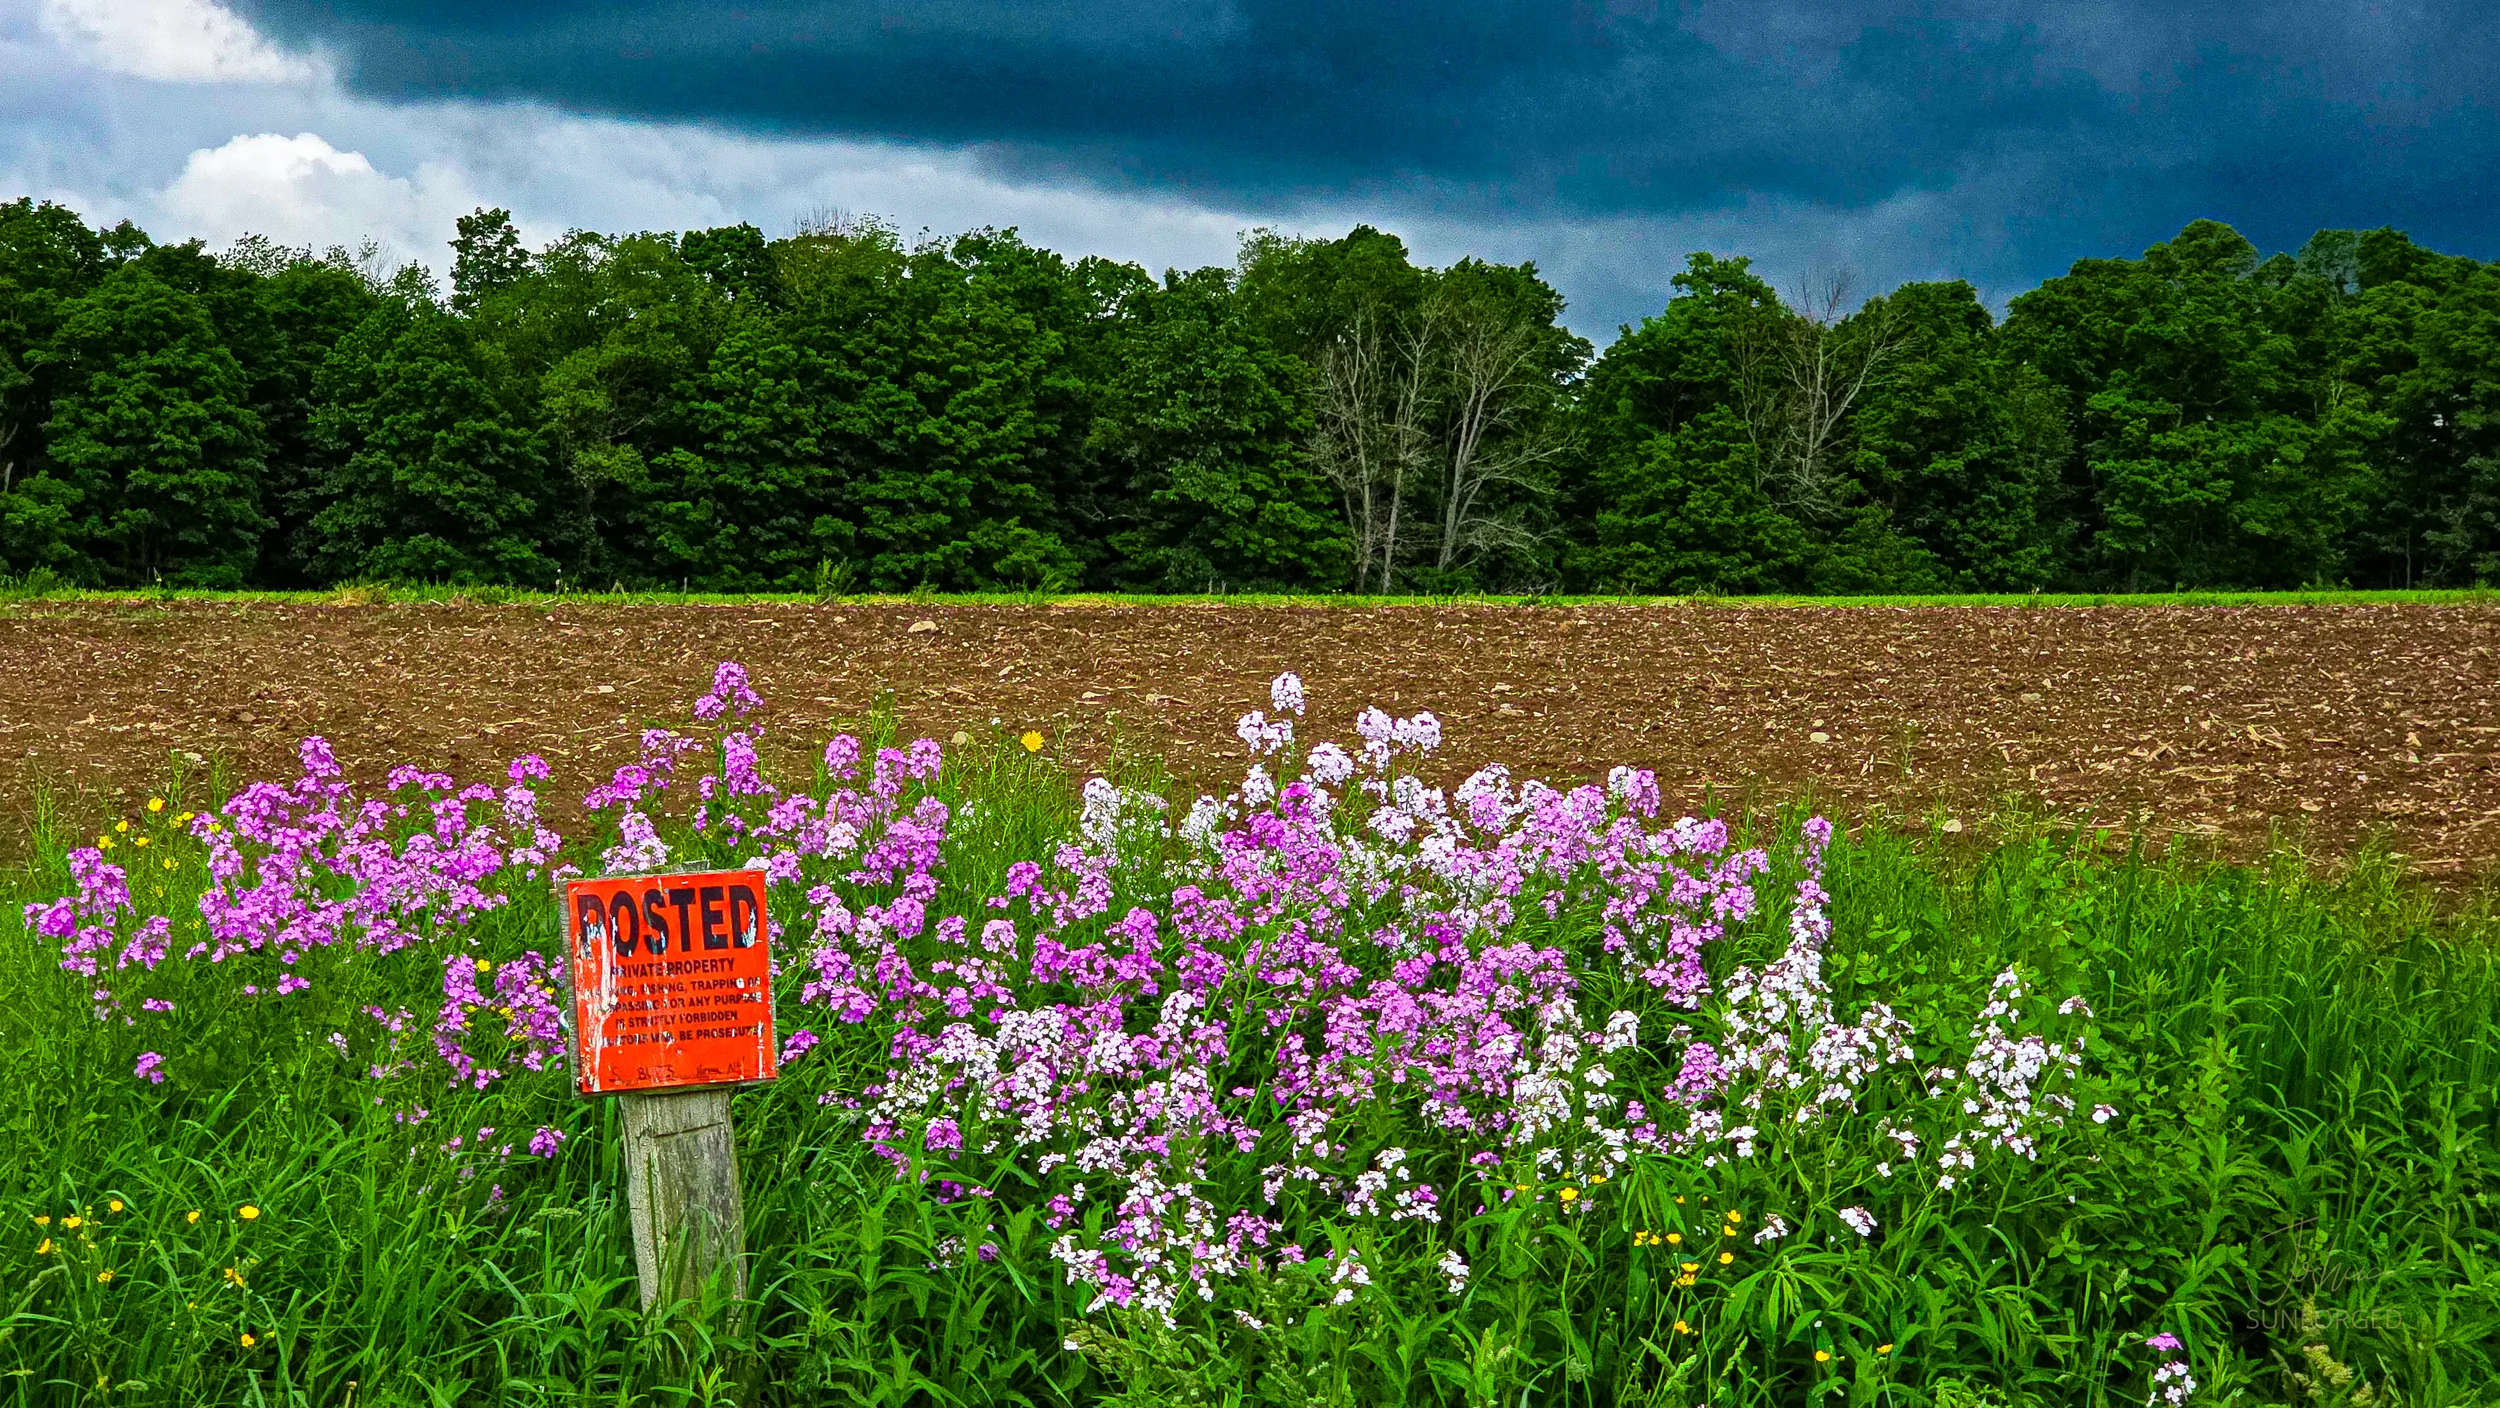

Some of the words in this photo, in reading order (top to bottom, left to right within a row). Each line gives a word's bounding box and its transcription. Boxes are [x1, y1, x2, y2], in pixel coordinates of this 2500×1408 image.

[577, 885, 759, 957] POSTED
[611, 962, 664, 978] PRIVATE
[667, 957, 735, 976] PROPERTY
[690, 977, 744, 991] TRAPPIN
[689, 996, 710, 1008] ANY
[714, 992, 762, 1006] PURPS
[680, 1010, 738, 1023] FORBIDDEN
[679, 1029, 693, 1041] BE
[696, 1025, 765, 1040] PROSECUT
